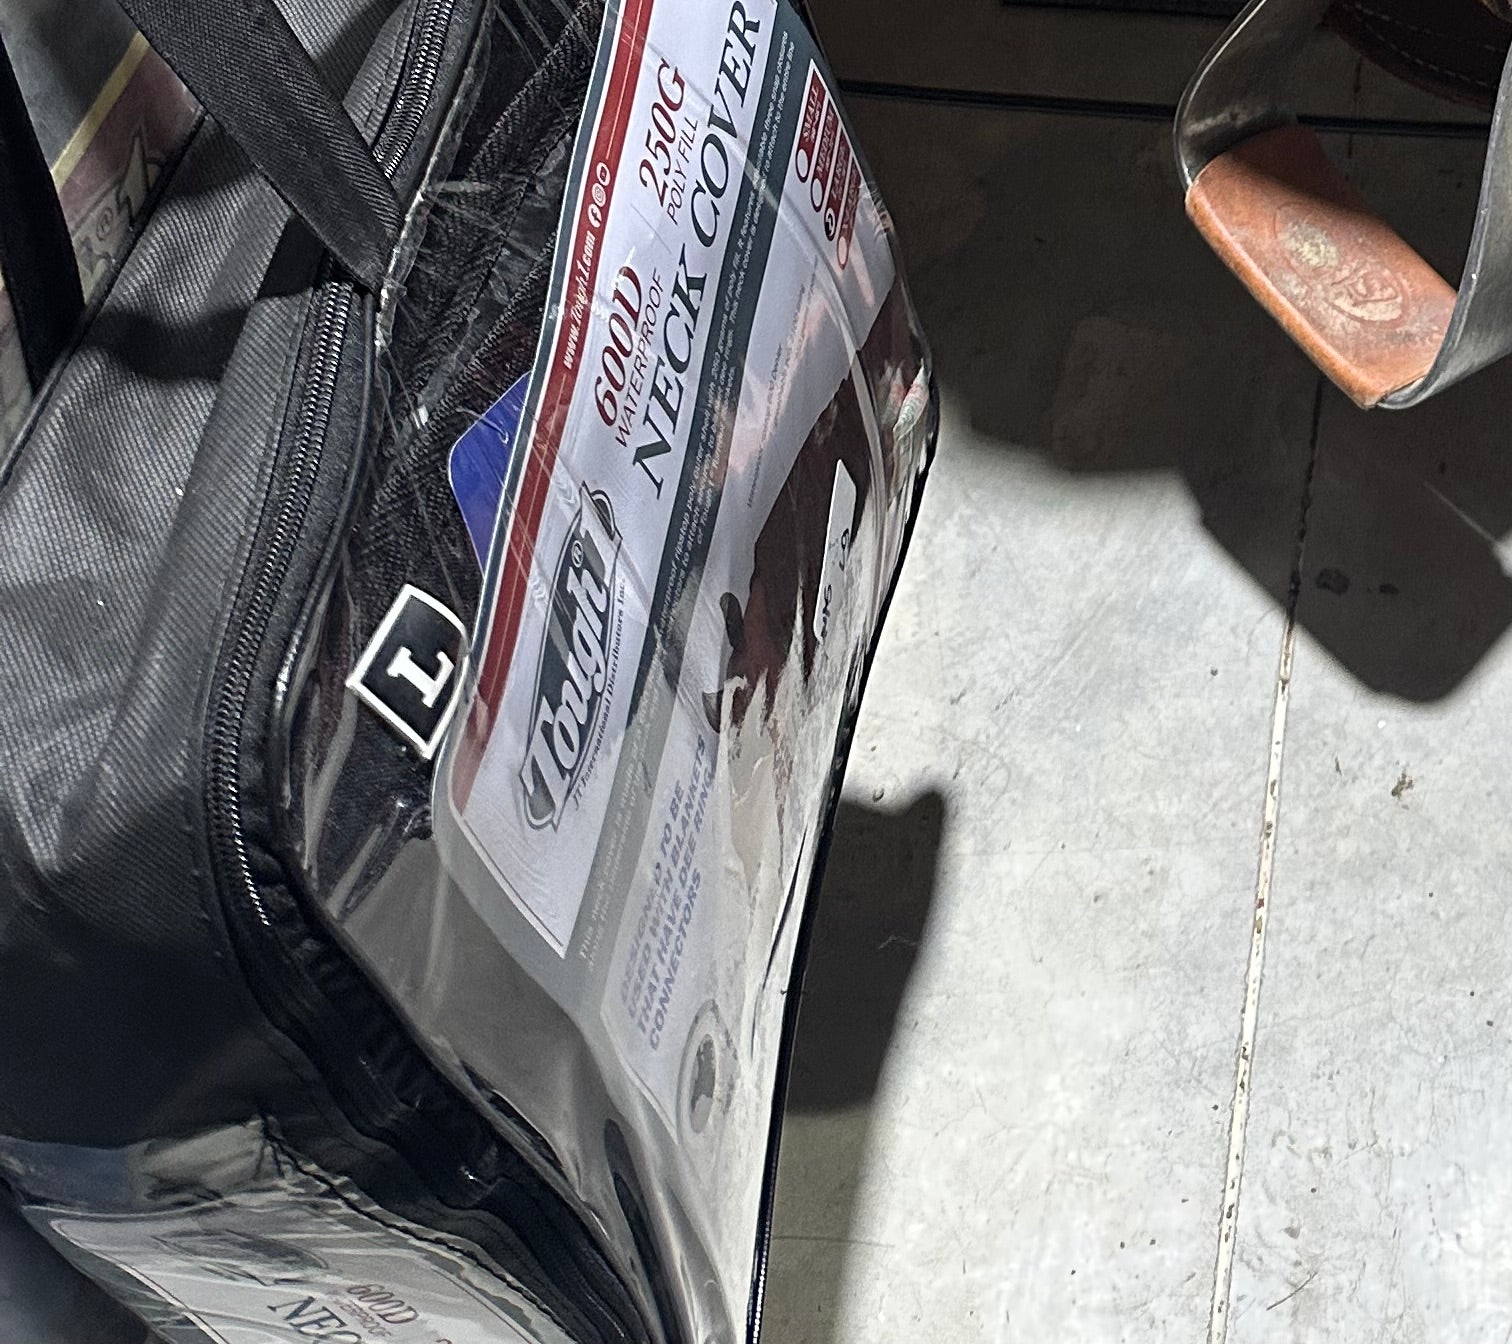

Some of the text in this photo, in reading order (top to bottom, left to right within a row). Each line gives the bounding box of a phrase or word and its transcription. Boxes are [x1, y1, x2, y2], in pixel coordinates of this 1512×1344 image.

[563, 230, 597, 369] www.Tough1.com
[594, 58, 689, 427] 600D 250G
[615, 114, 697, 445] WATERPROOF POLY FILL
[632, 0, 761, 499] NECK COVER
[386, 646, 455, 709] L
[658, 821, 673, 857] TO
[667, 778, 684, 822] BE
[669, 732, 708, 867] BLANKETS
[636, 960, 661, 1036] THAT
[656, 888, 682, 966] HAVE
[677, 834, 697, 888] DEE
[649, 866, 702, 1051] CONNECTORS
